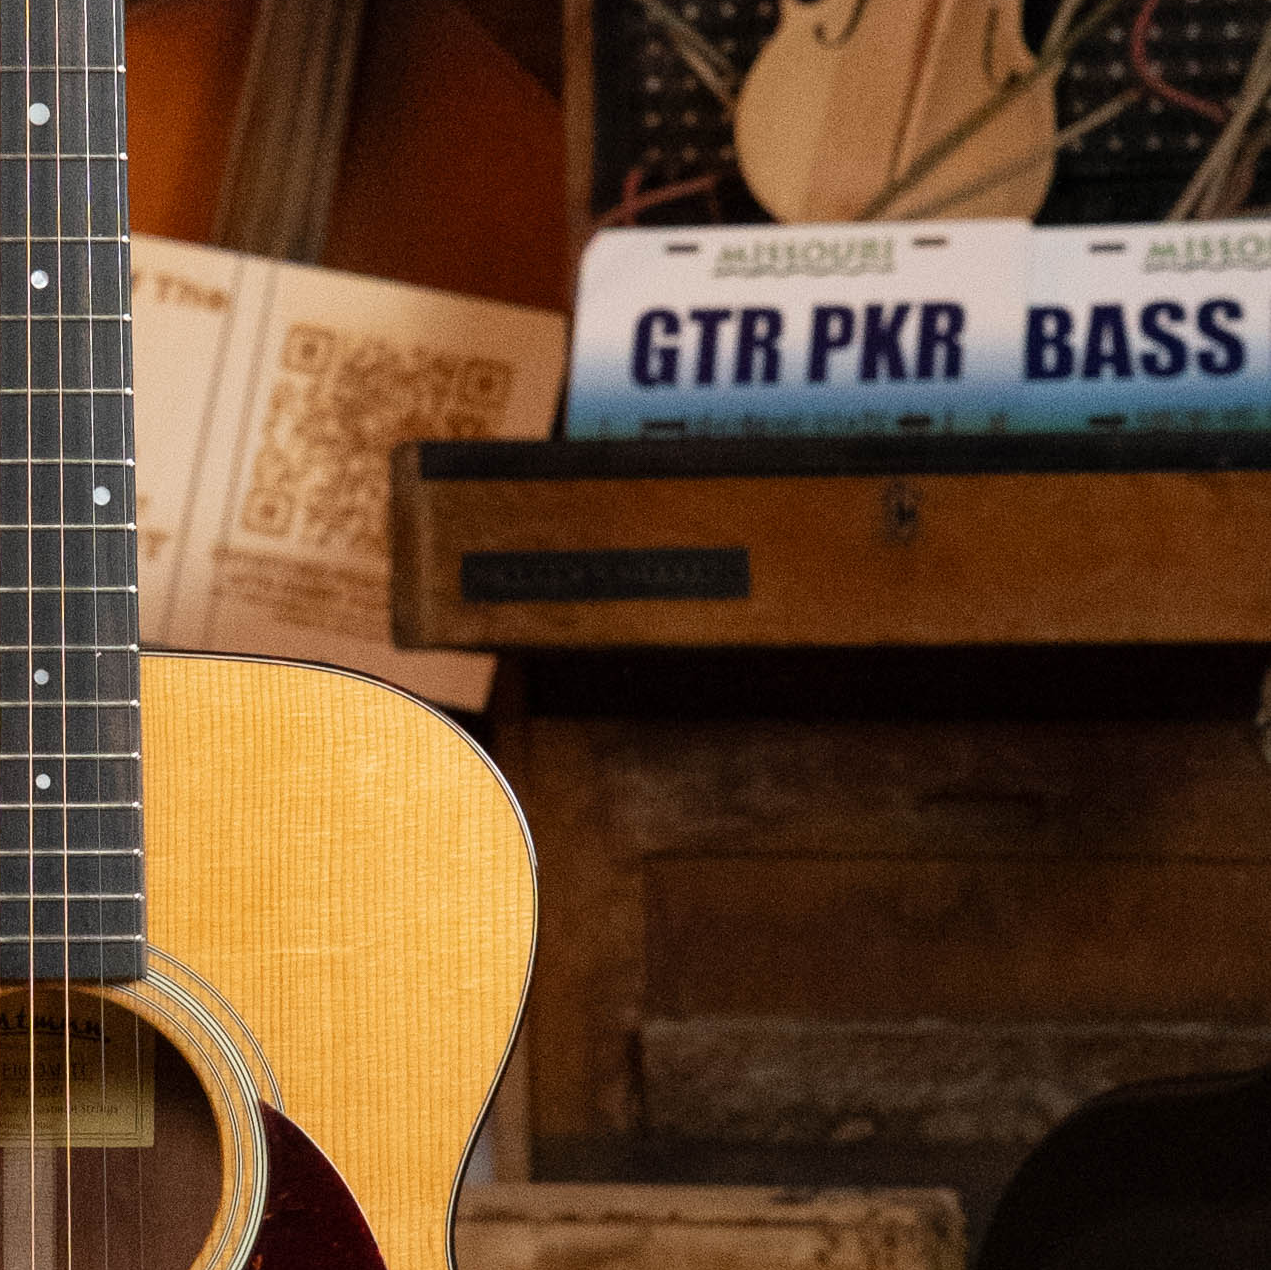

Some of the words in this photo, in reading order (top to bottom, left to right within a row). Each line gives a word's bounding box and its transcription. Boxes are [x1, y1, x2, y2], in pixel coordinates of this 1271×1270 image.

[713, 235, 897, 273] MISSOURI
[1143, 232, 1271, 270] MISSO
[632, 305, 785, 389] GTR
[806, 300, 967, 384] PKR
[1021, 298, 1248, 382] BASS
